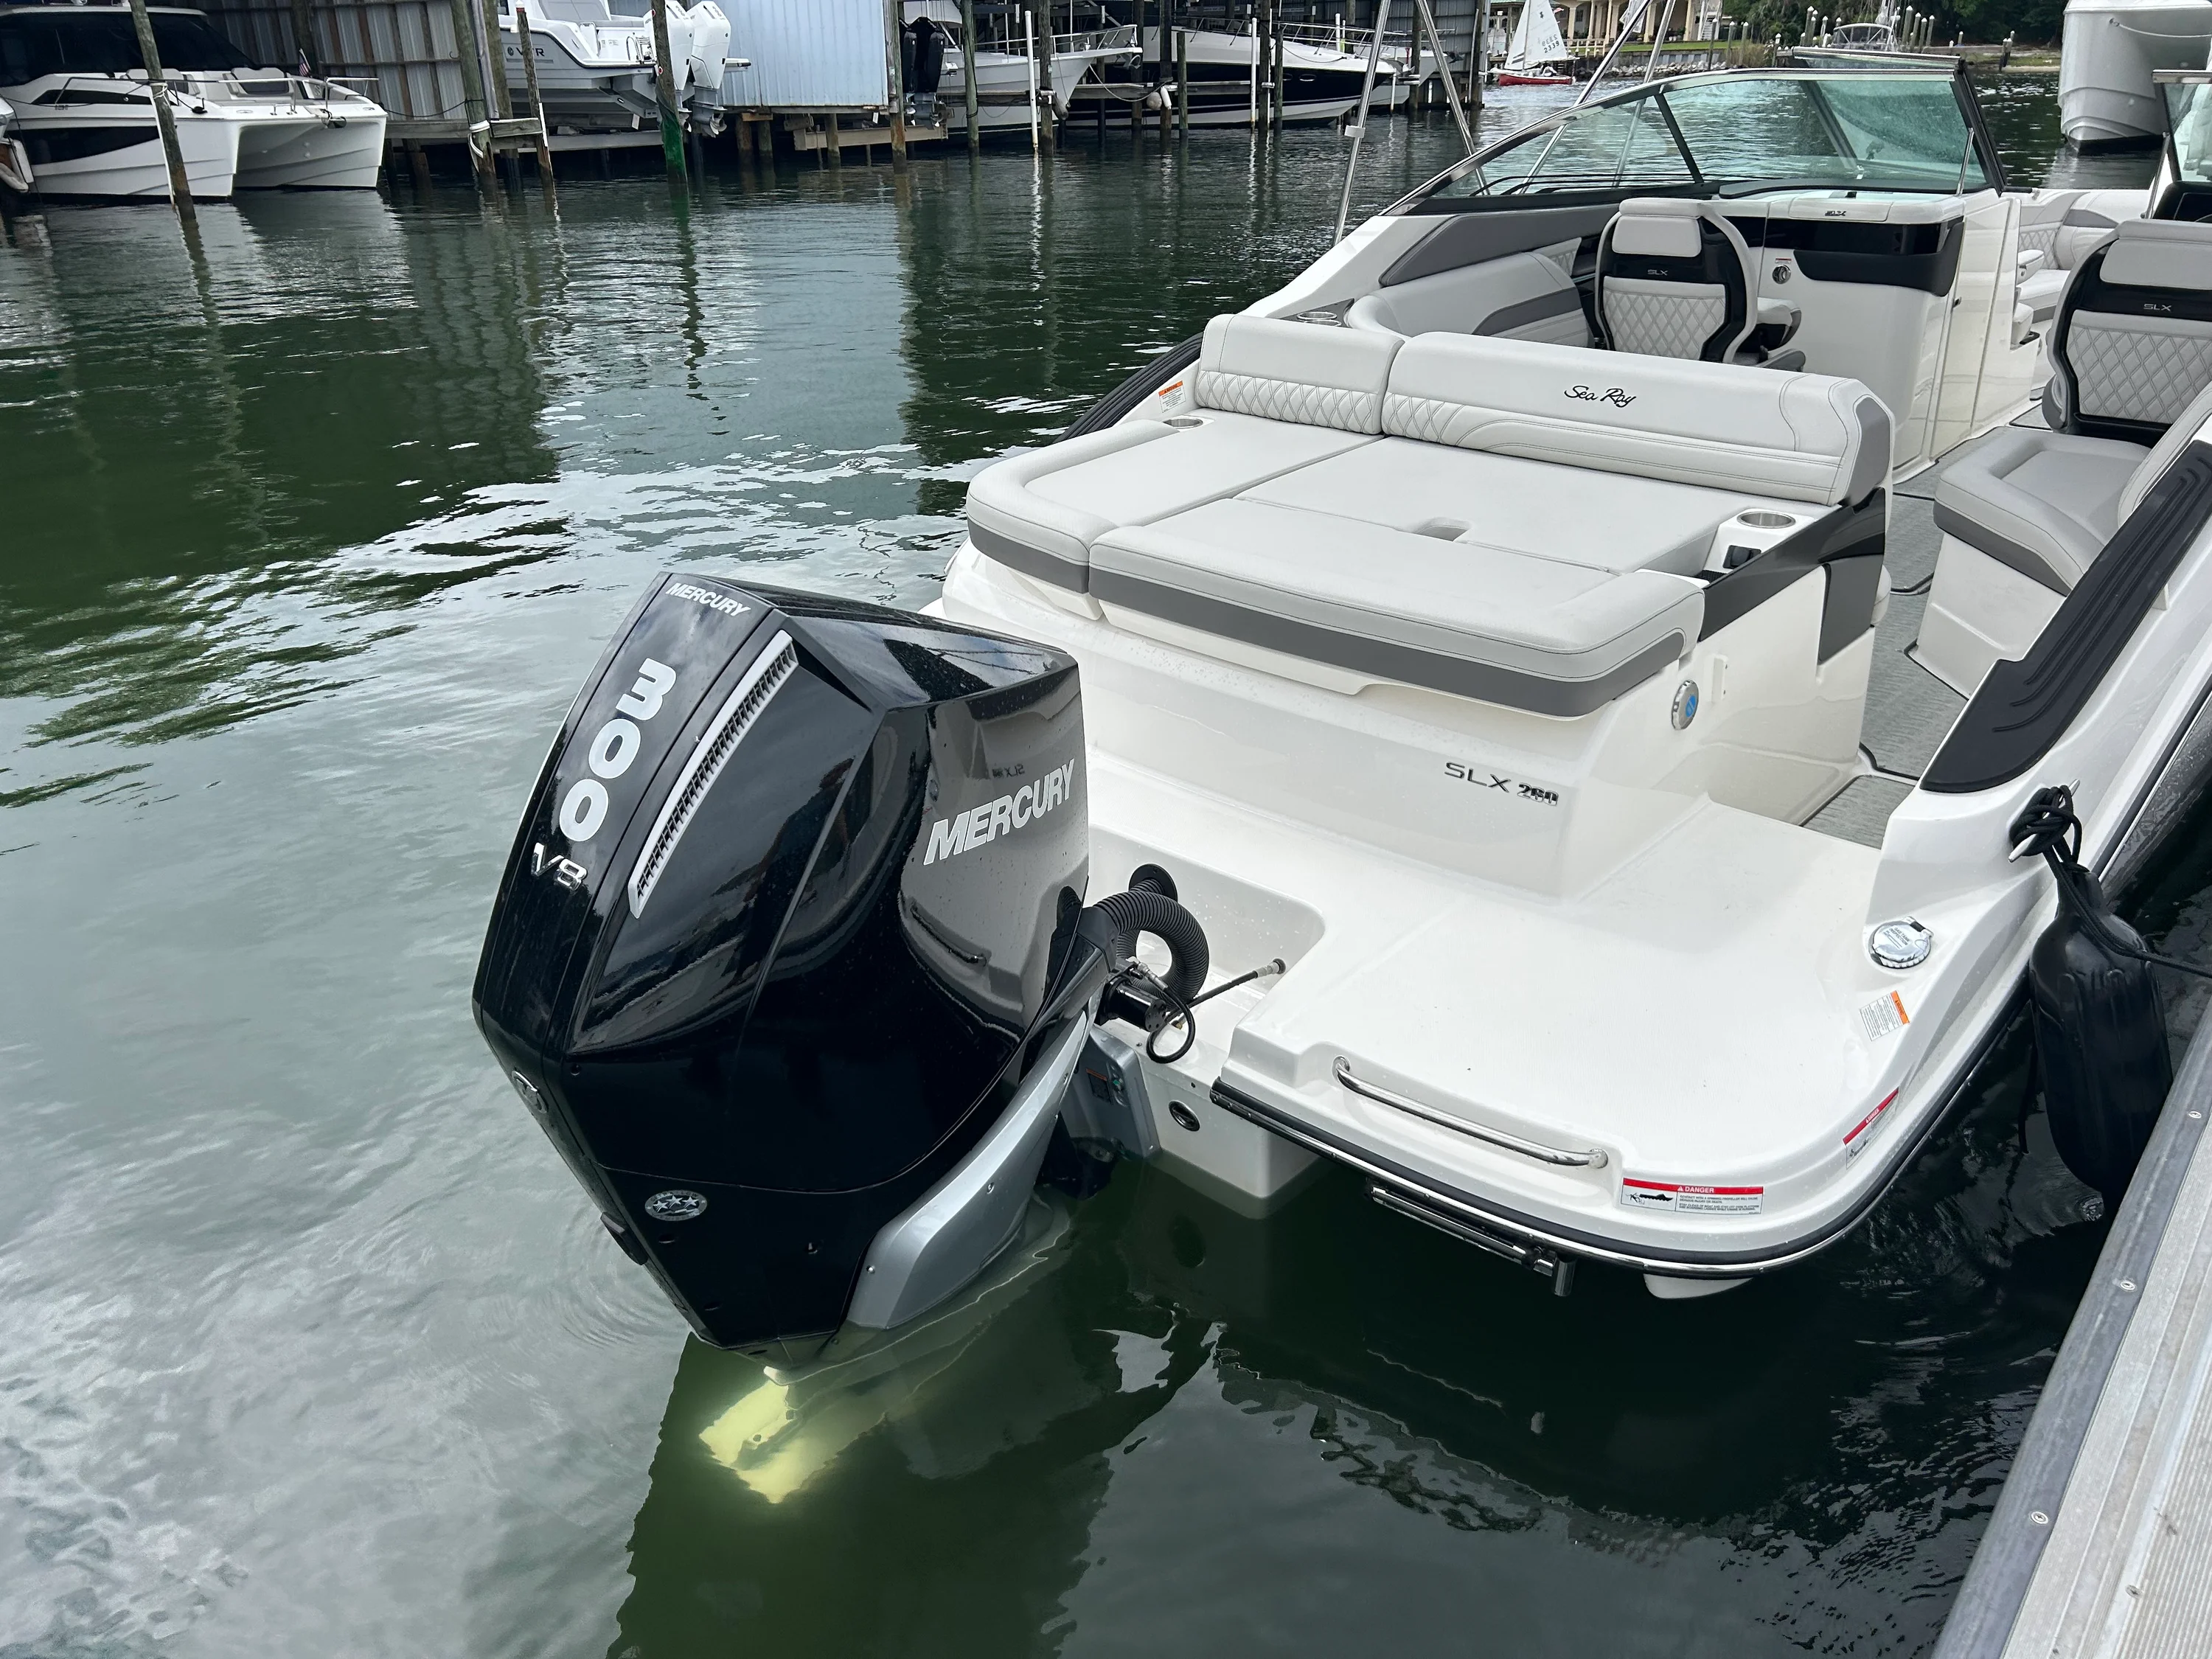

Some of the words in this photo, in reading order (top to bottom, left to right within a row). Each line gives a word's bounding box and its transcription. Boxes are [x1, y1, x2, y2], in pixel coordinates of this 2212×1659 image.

[1543, 41, 1560, 53] 2339
[2143, 303, 2172, 312] SLX
[1564, 385, 1599, 400] Sea
[1600, 388, 1637, 408] Ray
[665, 582, 751, 616] MERCURY
[559, 658, 677, 842] 300
[1444, 761, 1512, 793] SLX
[1517, 782, 1559, 806] 260
[923, 758, 1074, 866] MERCURY
[531, 842, 588, 894] V8
[1685, 1186, 1714, 1194] DANGER
